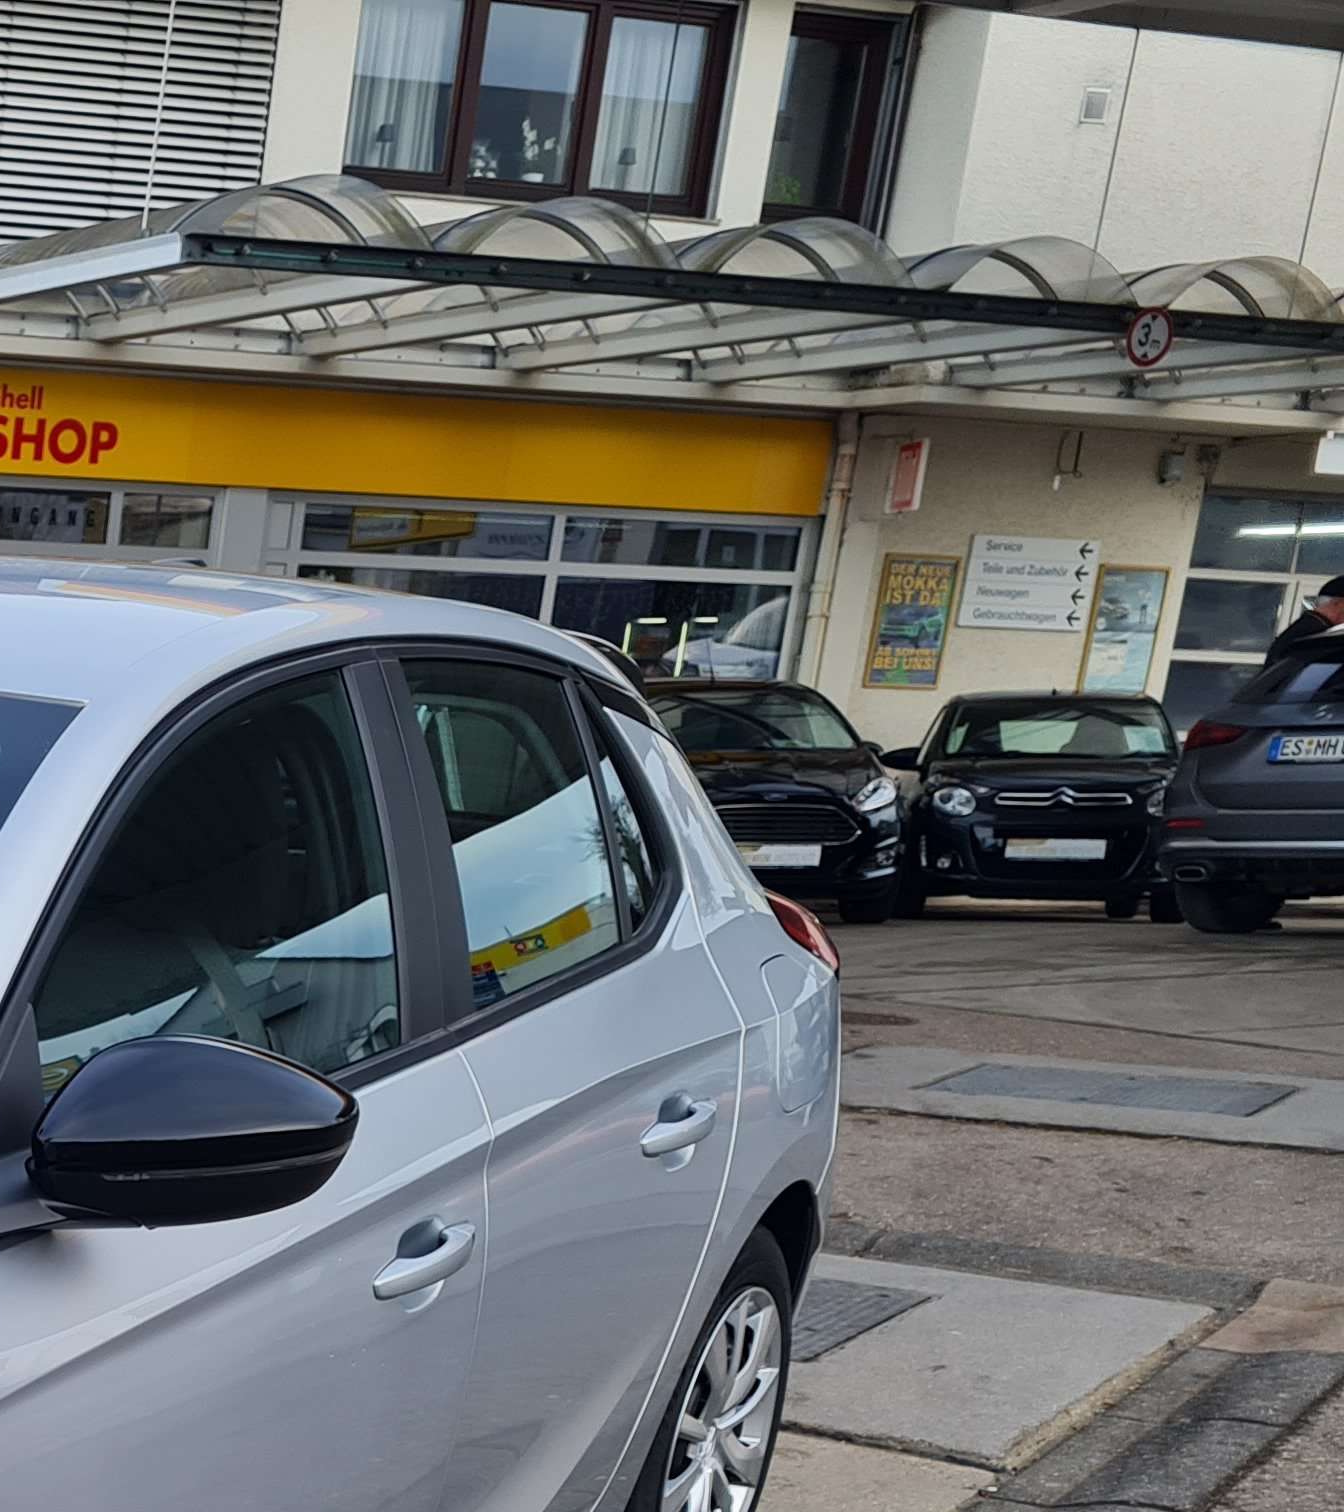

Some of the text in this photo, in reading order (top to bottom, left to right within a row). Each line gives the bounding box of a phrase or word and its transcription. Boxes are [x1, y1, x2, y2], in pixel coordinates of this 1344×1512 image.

[1137, 322, 1153, 346] 3
[985, 539, 1024, 552] Service
[887, 575, 949, 592] MOKKA
[885, 590, 914, 605] IST
[1280, 738, 1304, 756] ES
